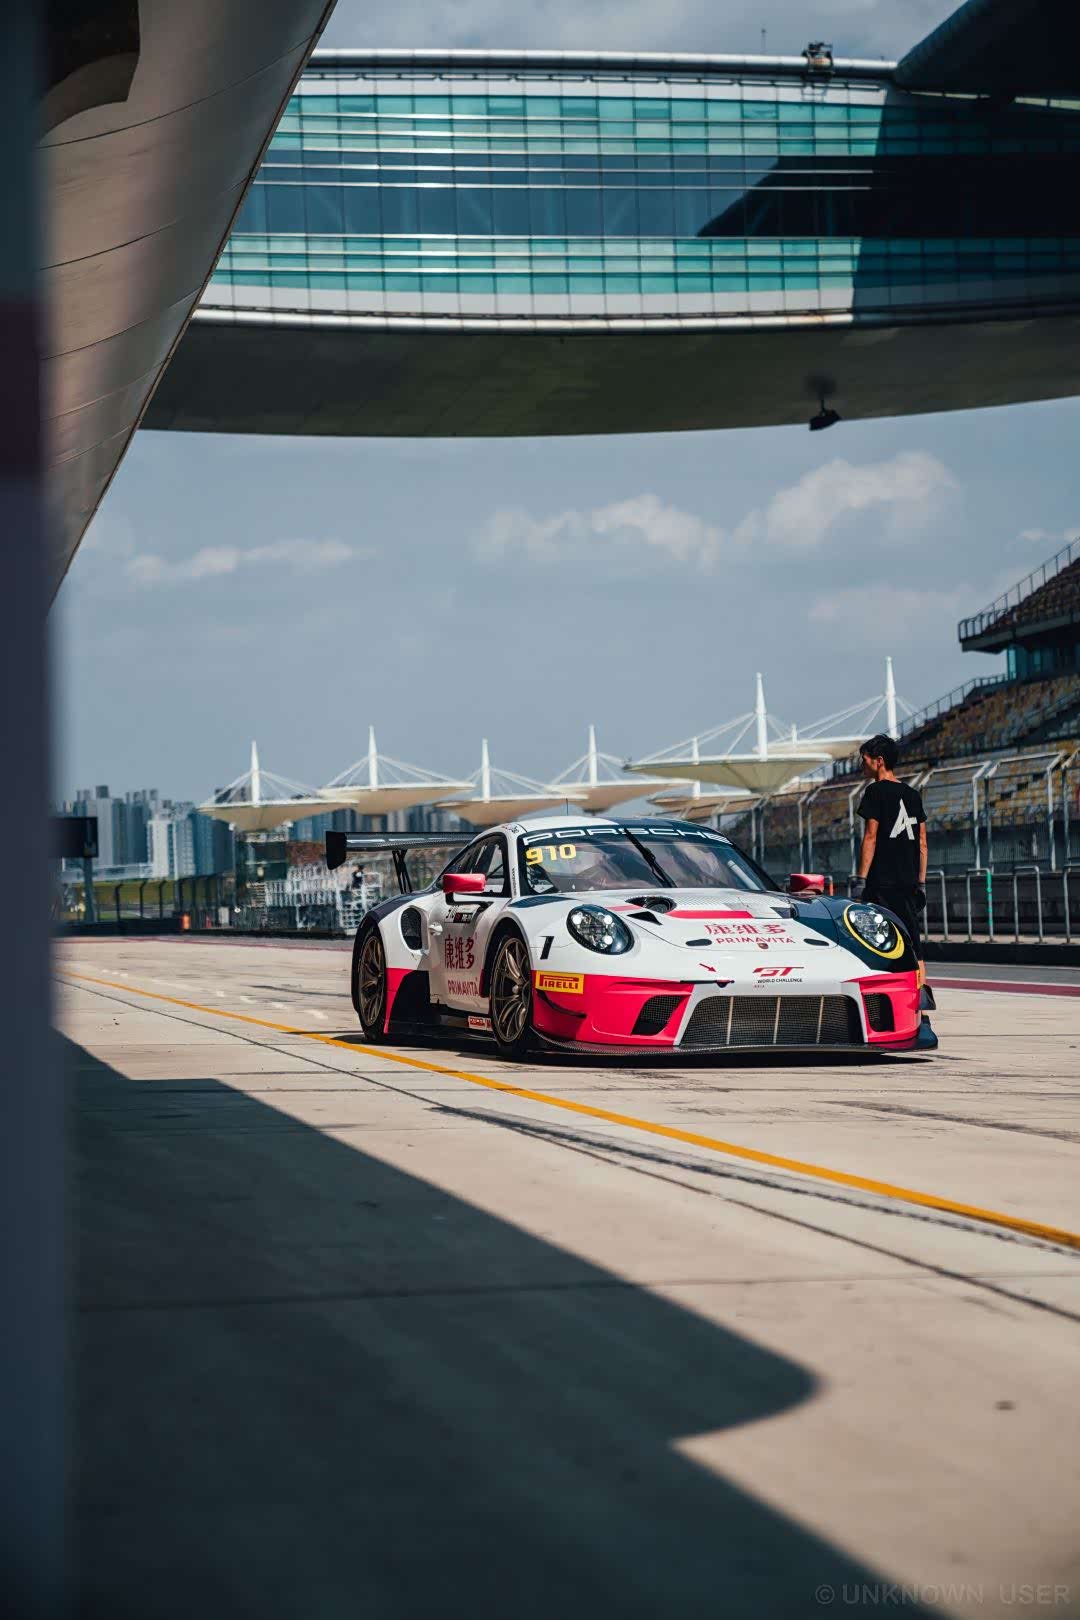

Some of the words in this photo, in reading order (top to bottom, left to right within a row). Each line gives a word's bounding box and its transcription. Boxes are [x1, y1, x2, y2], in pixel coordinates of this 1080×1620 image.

[522, 827, 734, 846] PORSCHE
[525, 843, 577, 866] 910
[444, 935, 475, 970] 康维多
[539, 974, 580, 990] PIRELLI
